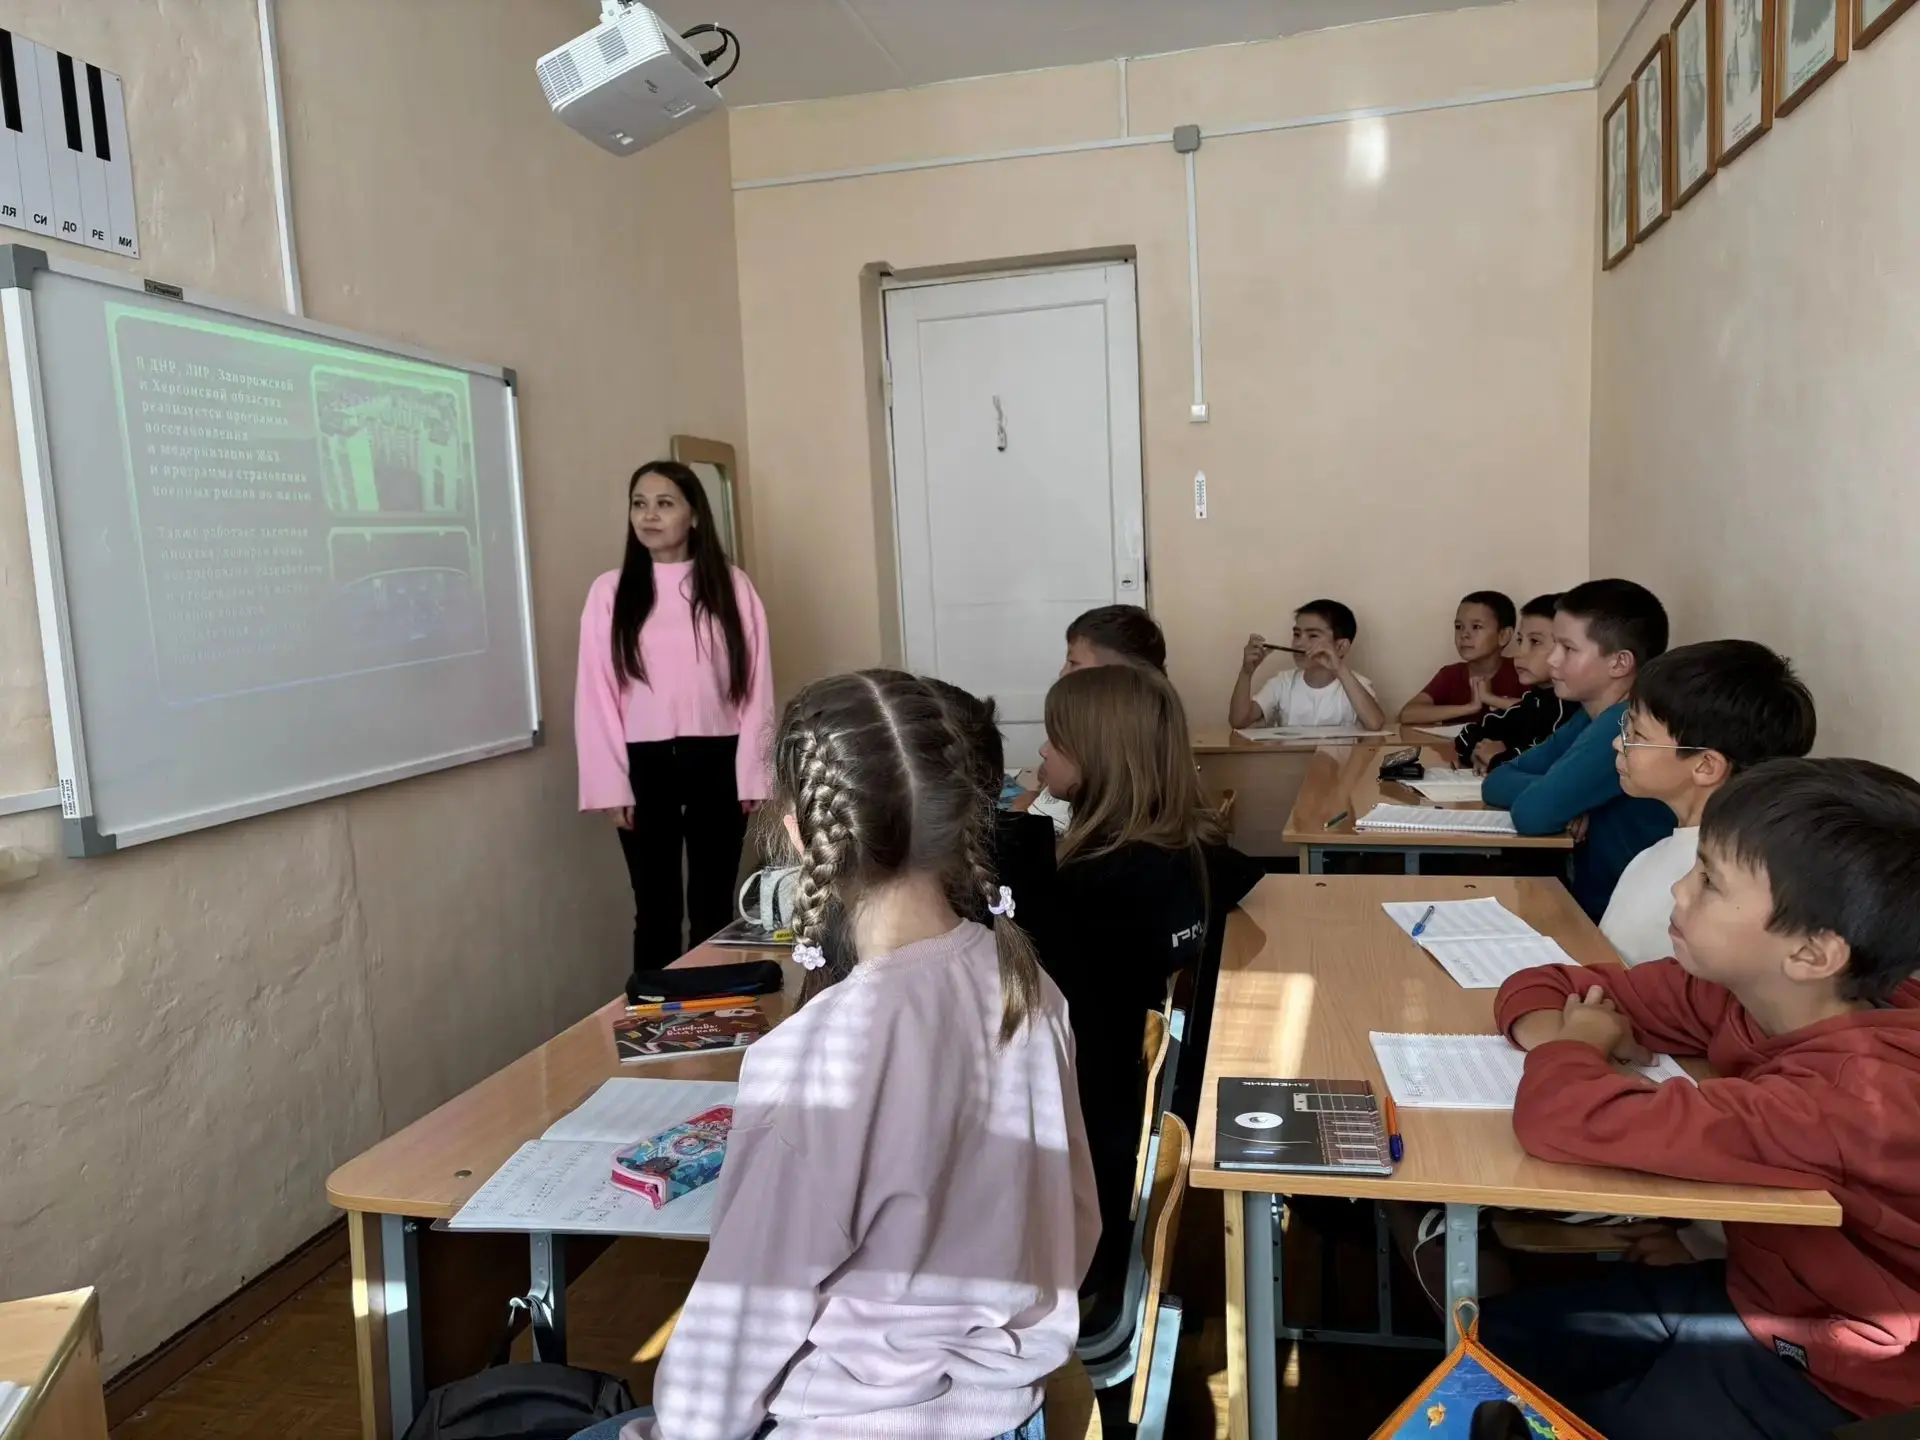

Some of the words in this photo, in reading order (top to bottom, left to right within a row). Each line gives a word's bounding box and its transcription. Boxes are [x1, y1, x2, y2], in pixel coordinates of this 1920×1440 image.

[2, 205, 17, 217] ЛЯ
[33, 214, 48, 226] СИ
[62, 221, 77, 233] ДО
[92, 229, 104, 241] РЕ
[118, 236, 132, 248] МИ
